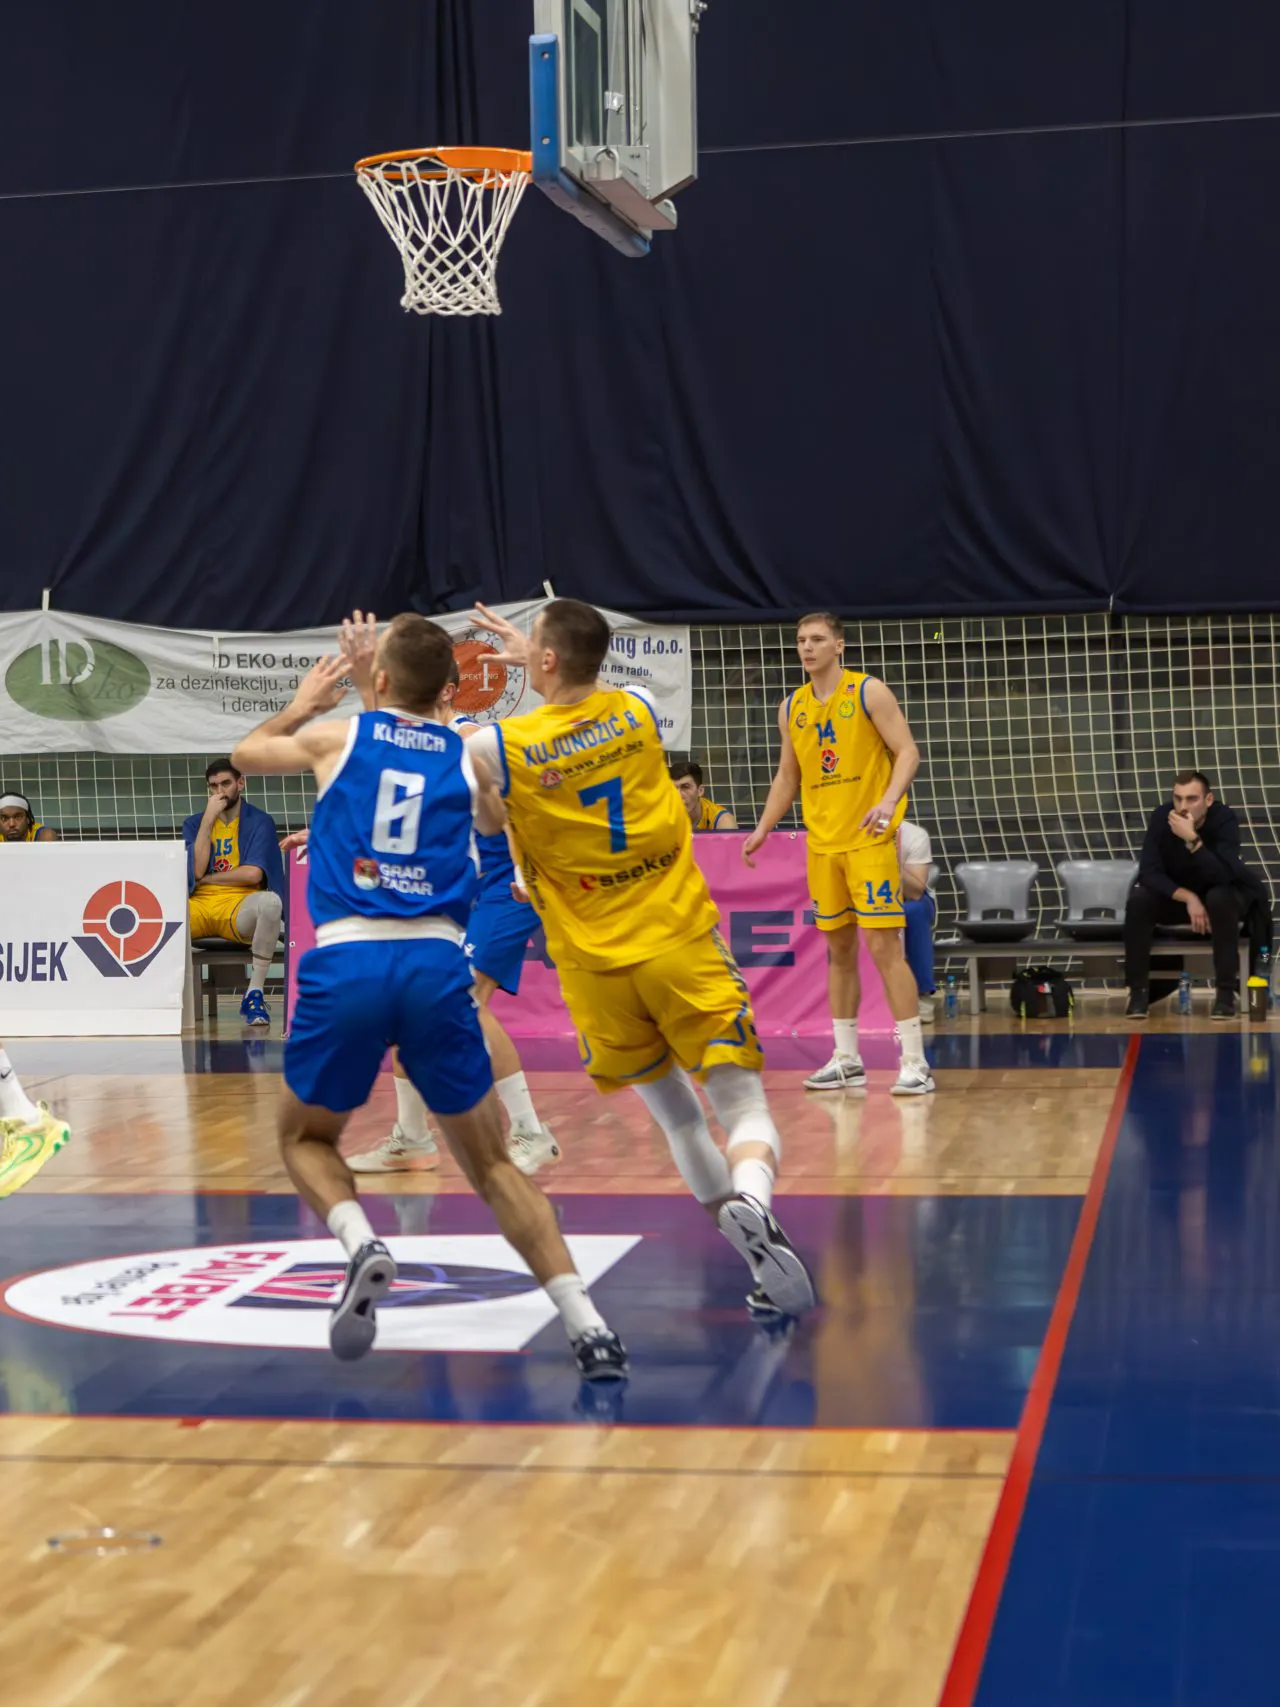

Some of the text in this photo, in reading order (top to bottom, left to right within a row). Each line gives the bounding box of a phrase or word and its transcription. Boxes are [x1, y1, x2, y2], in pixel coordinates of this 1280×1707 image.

[643, 636, 683, 655] d.o.o.
[237, 653, 276, 668] EKO
[156, 677, 176, 690] za
[180, 674, 283, 694] dezinfekciju,
[815, 719, 837, 745] 14
[578, 776, 628, 854] 7
[214, 837, 233, 857] 15
[379, 862, 427, 881] GRAD
[380, 876, 434, 897] ZADAR
[865, 880, 893, 905] 14
[109, 1251, 289, 1321] FAVBET
